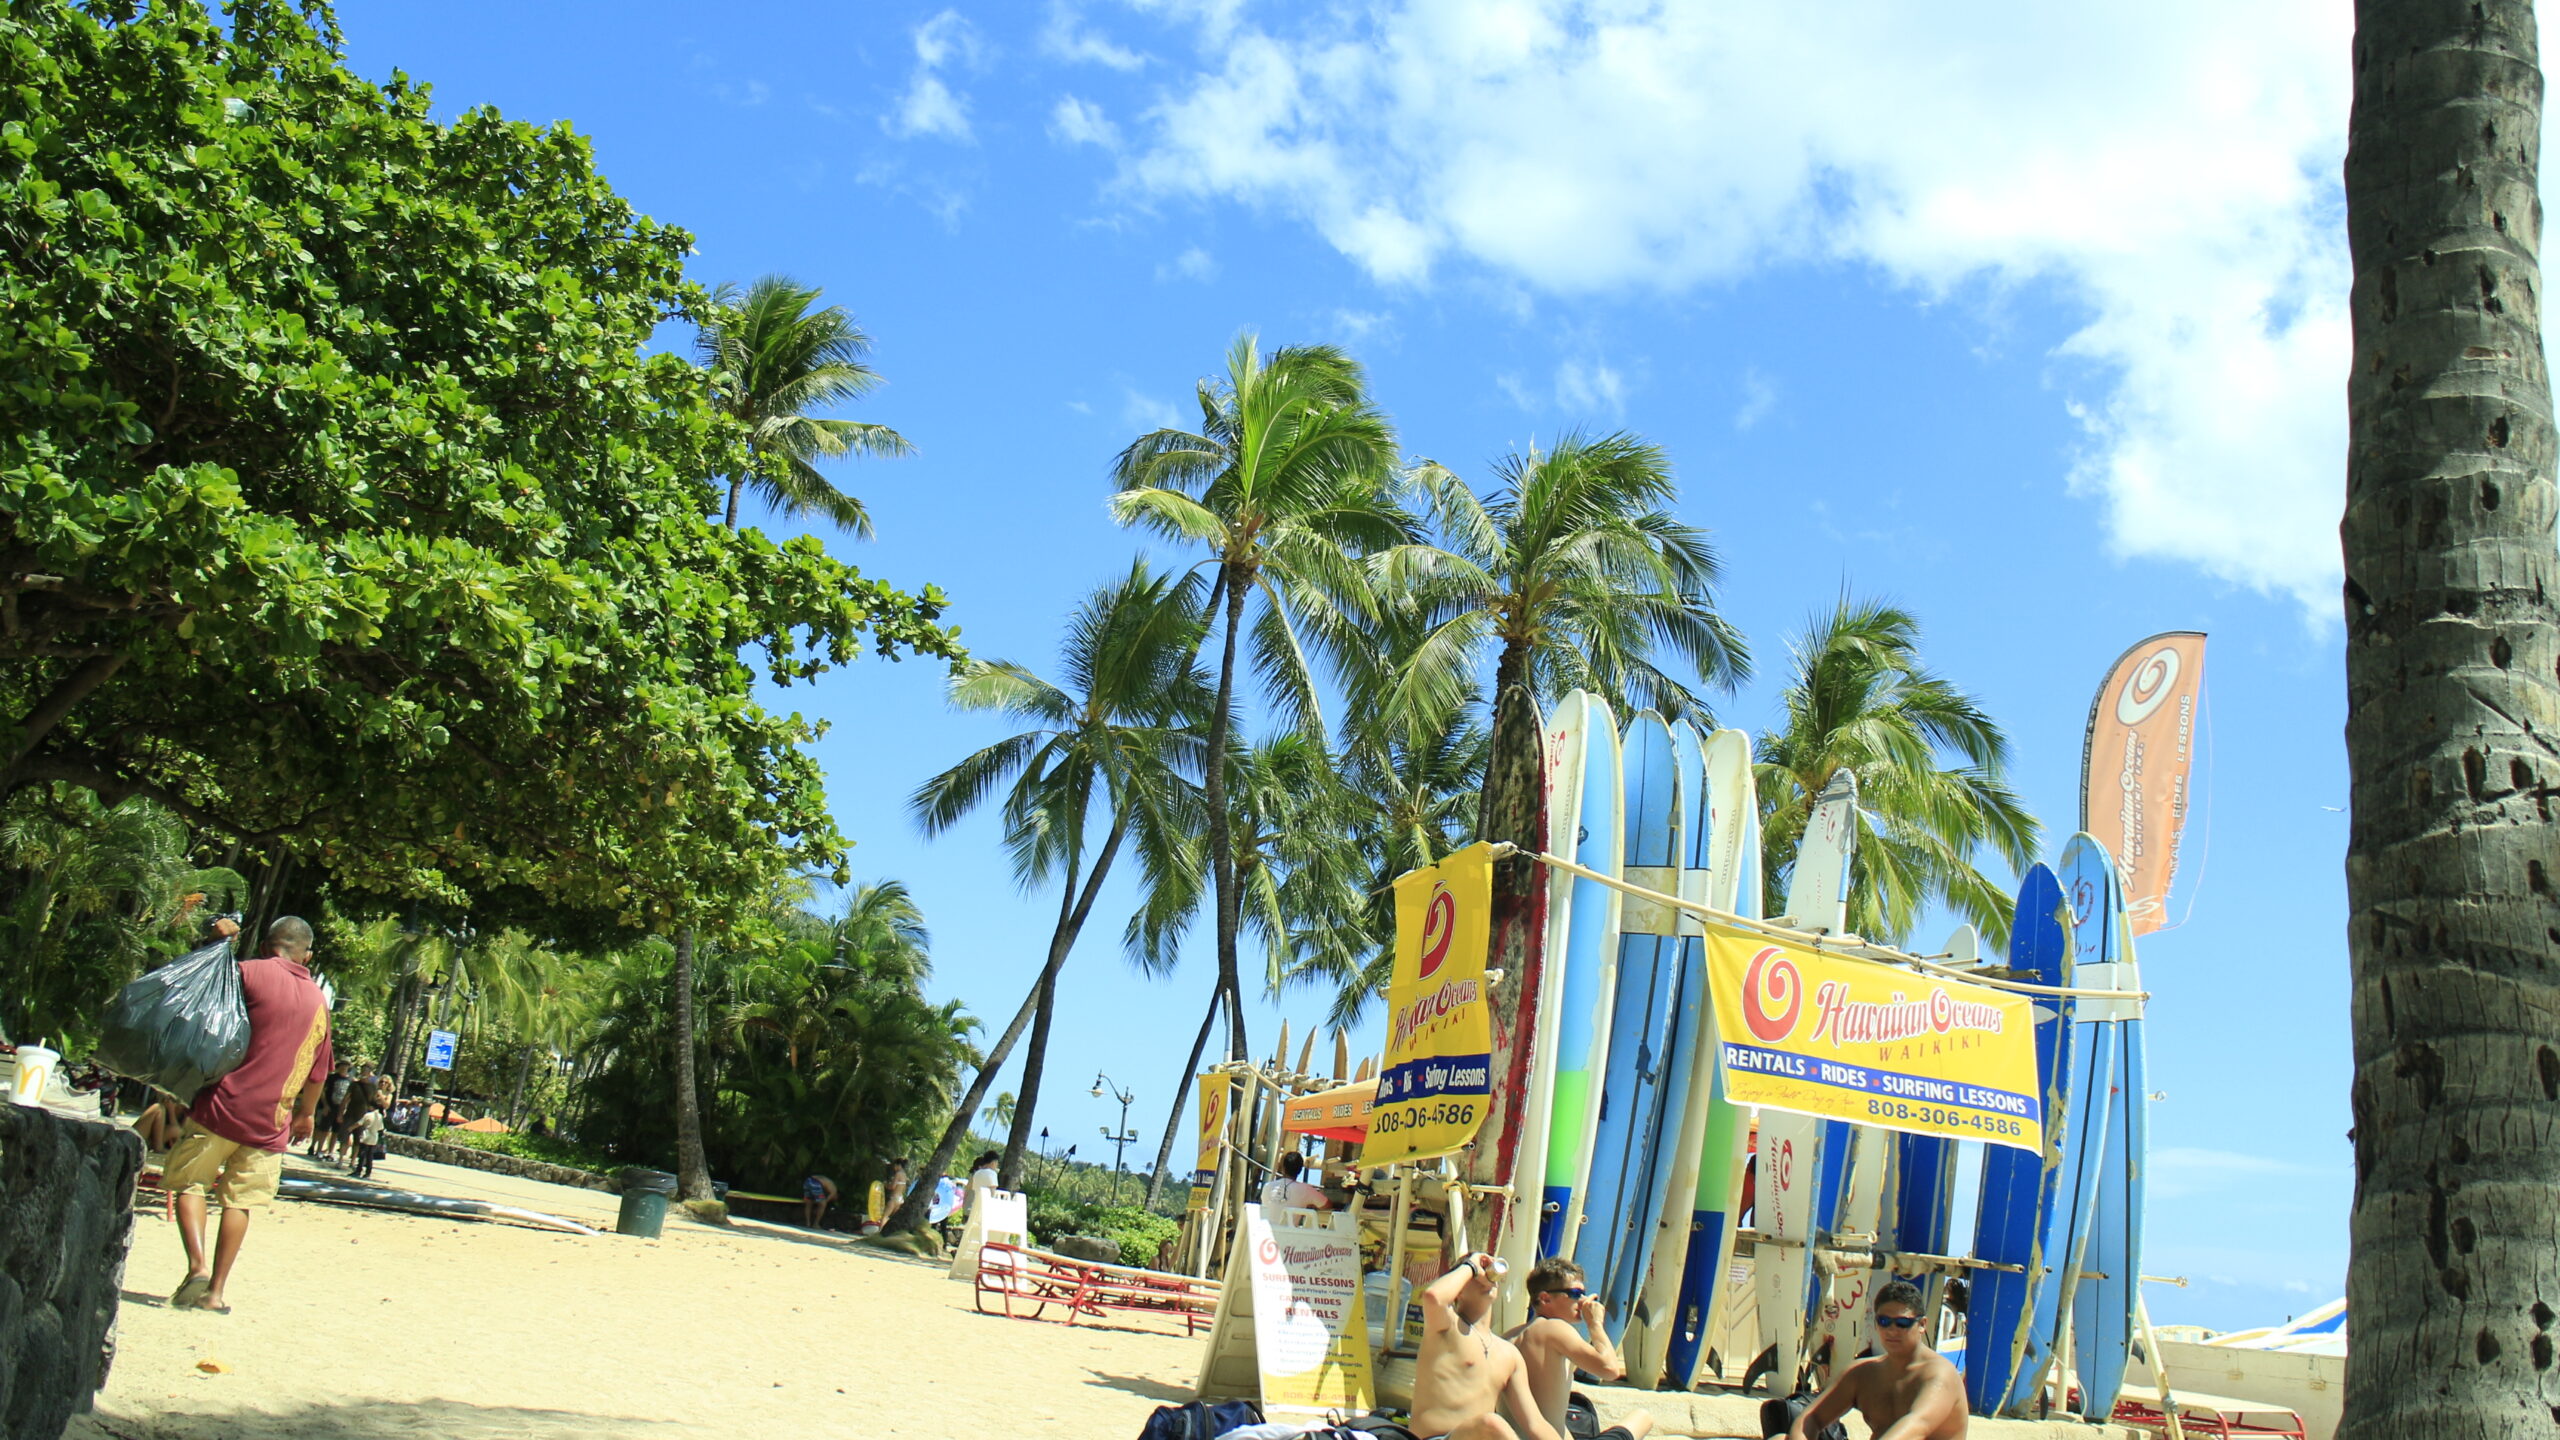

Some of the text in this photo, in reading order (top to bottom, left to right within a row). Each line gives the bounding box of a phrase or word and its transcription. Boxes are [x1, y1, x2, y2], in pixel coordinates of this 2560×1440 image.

[2176, 695, 2191, 762] LESSONS
[2117, 728, 2138, 892] Hawaiian Oceans
[2172, 775, 2183, 818] RIDES
[1810, 981, 2002, 1047] Hawaiian Oceans
[1879, 1034, 1982, 1062] WAIKIKI
[1448, 1064, 1486, 1087] Lessons
[1727, 1047, 2027, 1114] RENTALS RIDES SURFING LESSONS
[1291, 1109, 1322, 1121] RENTALS
[1332, 1104, 1353, 1118] RIDES
[1868, 1099, 2021, 1136] 808-306-4586
[1263, 1273, 1355, 1288] SURFING LESSONS
[1280, 1295, 1341, 1306] CANOE RIDES
[1285, 1307, 1339, 1319] RENTALS
